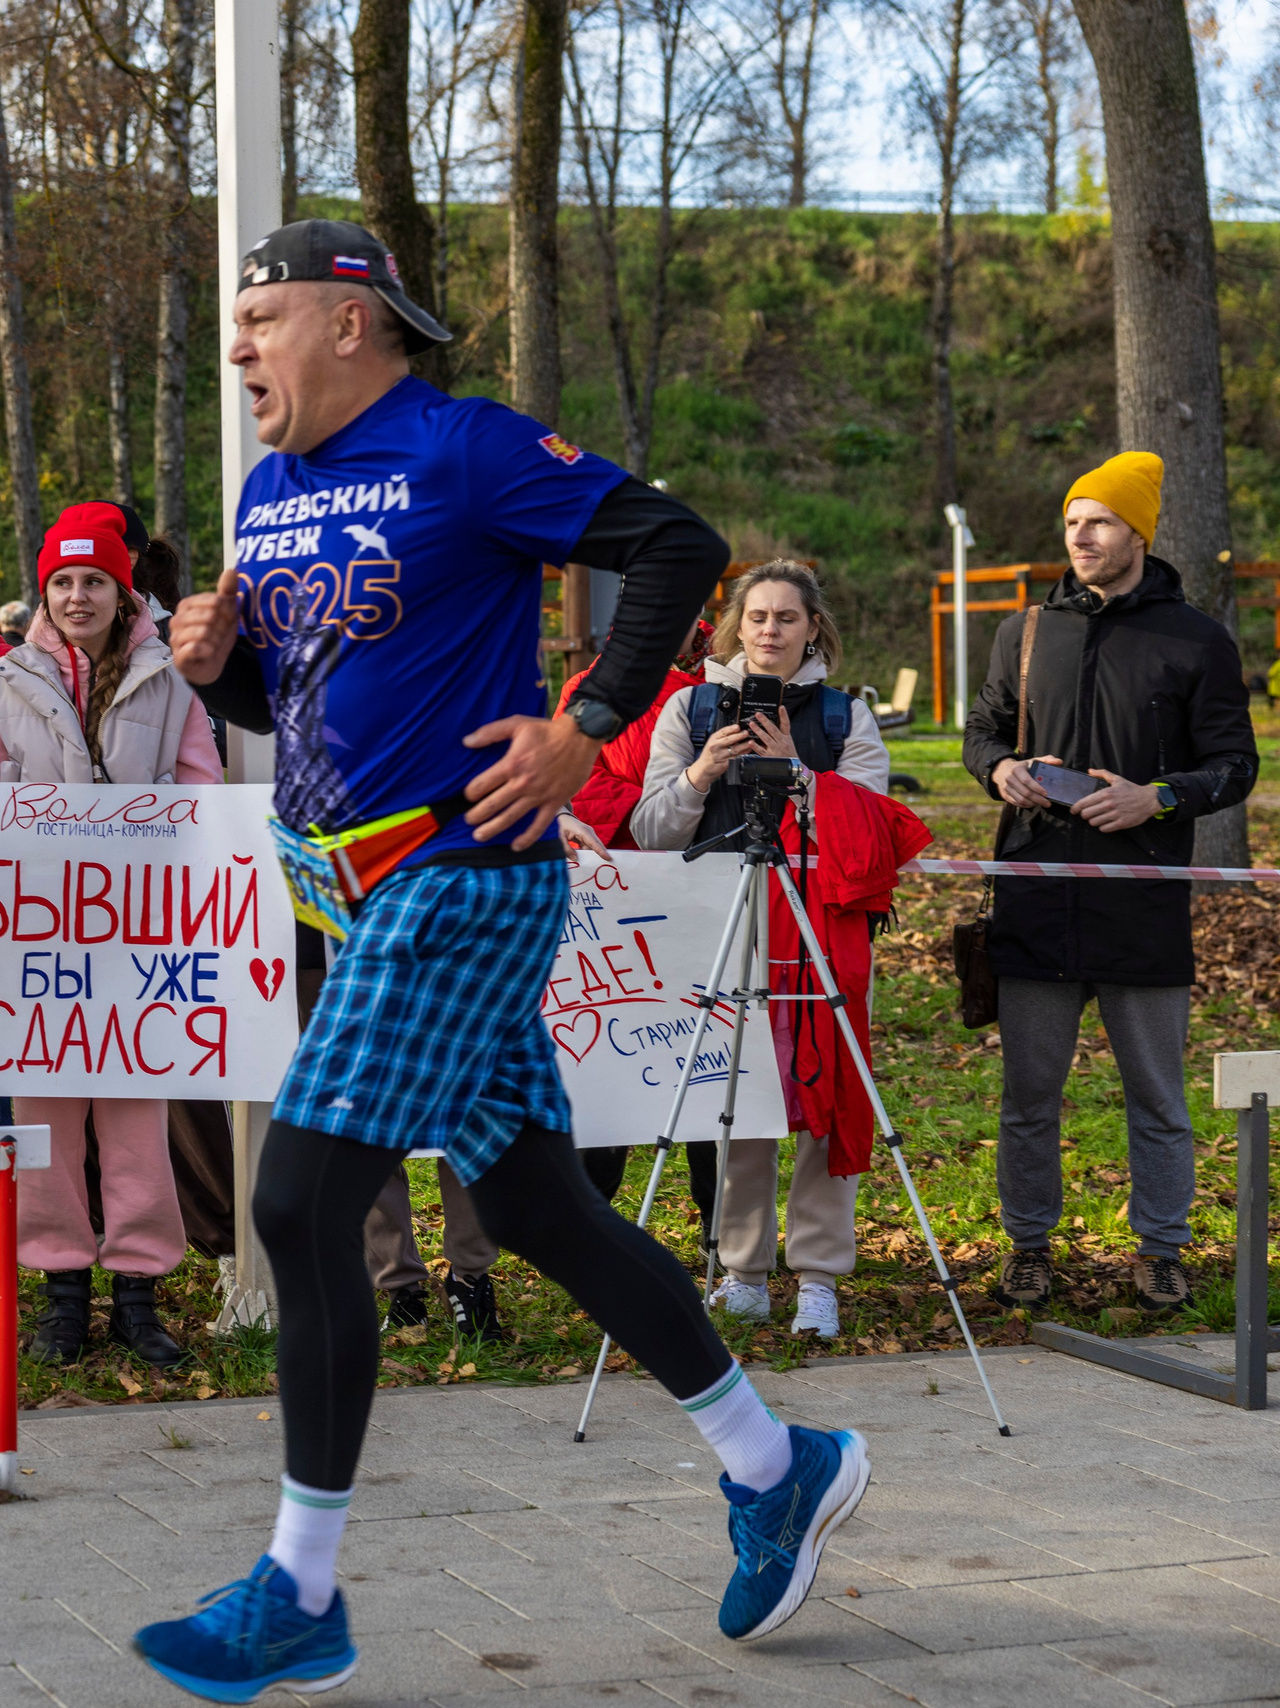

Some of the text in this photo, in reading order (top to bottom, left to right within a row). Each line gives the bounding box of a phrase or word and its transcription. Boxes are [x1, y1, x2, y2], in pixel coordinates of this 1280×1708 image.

[240, 473, 410, 530] РЖЕВСКИЙ
[236, 560, 403, 649] 2025
[1, 782, 199, 832] Волга
[37, 821, 177, 839] ГОСТИНИЦА-КОММУНА
[560, 905, 604, 945] АГ
[21, 951, 220, 1003] БЫ УЖЕ
[540, 930, 663, 1012] ЕДЕ!
